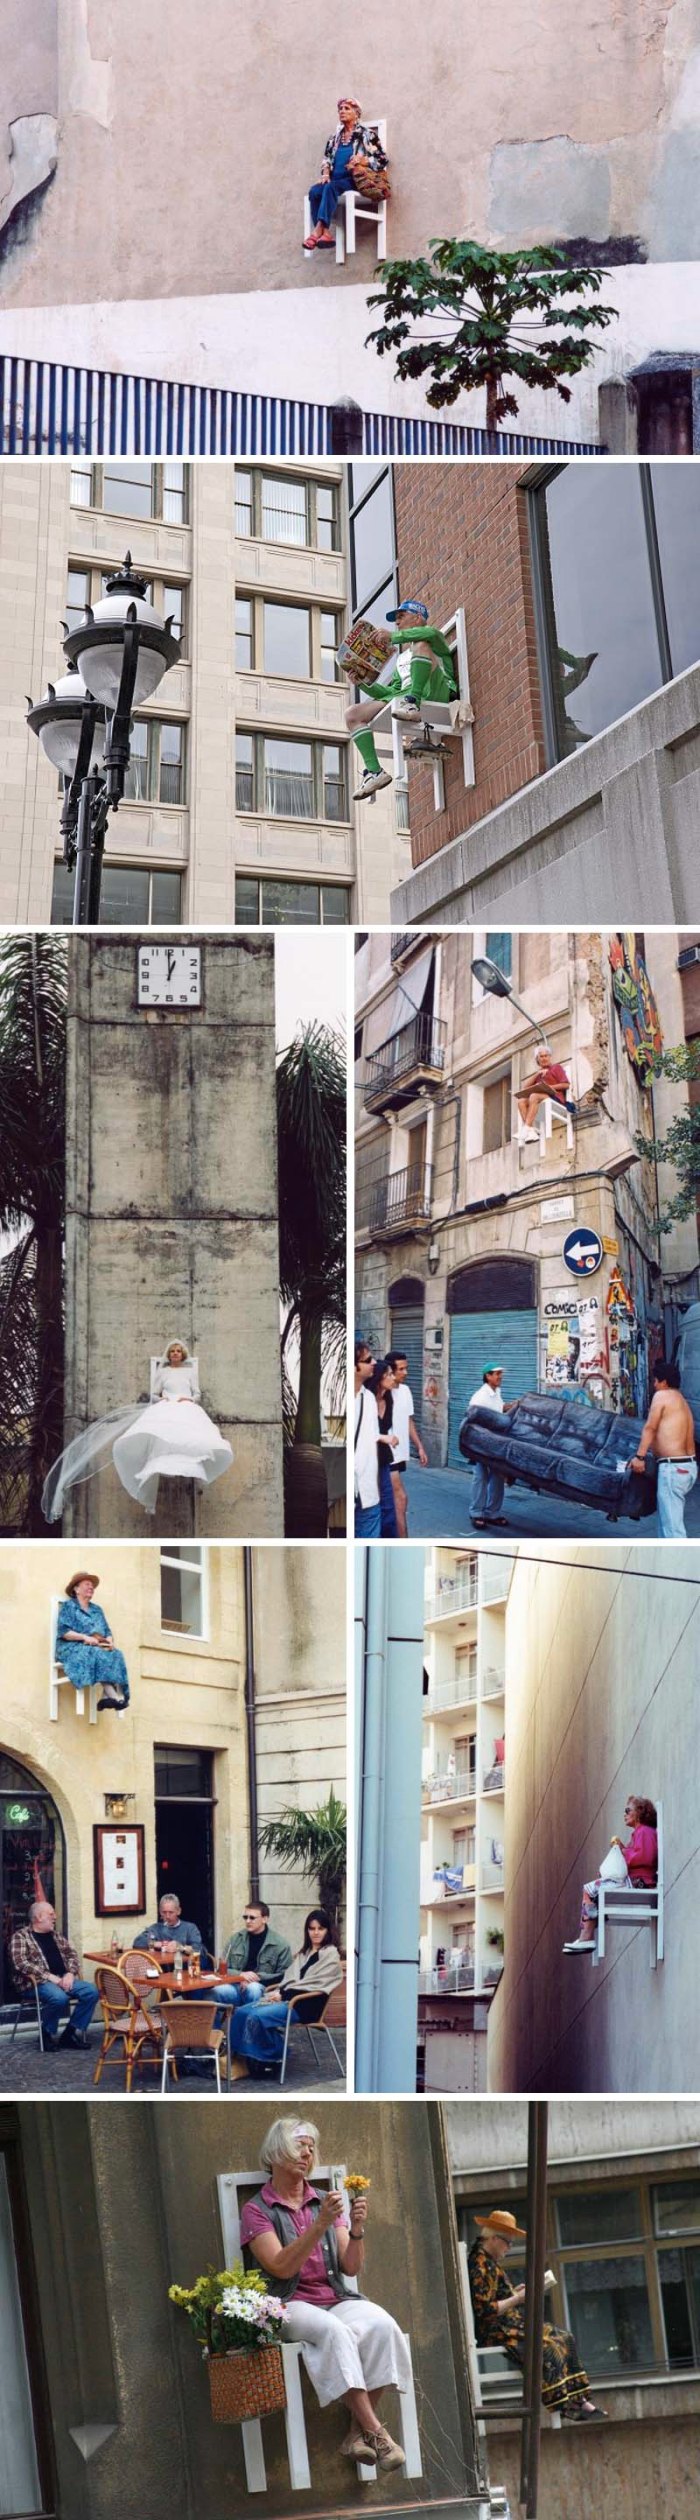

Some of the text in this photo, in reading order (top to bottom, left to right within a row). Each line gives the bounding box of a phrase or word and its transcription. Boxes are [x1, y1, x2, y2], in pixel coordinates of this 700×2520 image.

[151, 949, 159, 957] 11
[165, 949, 175, 957] 12
[181, 949, 185, 957] 1
[141, 958, 150, 967] 10
[190, 958, 198, 967] 2
[141, 971, 150, 979] 9
[190, 972, 198, 980] 3
[141, 985, 150, 993] 8
[190, 985, 198, 993] 4
[152, 994, 160, 1002] 7
[165, 994, 174, 1002] 6
[179, 994, 188, 1003] 5
